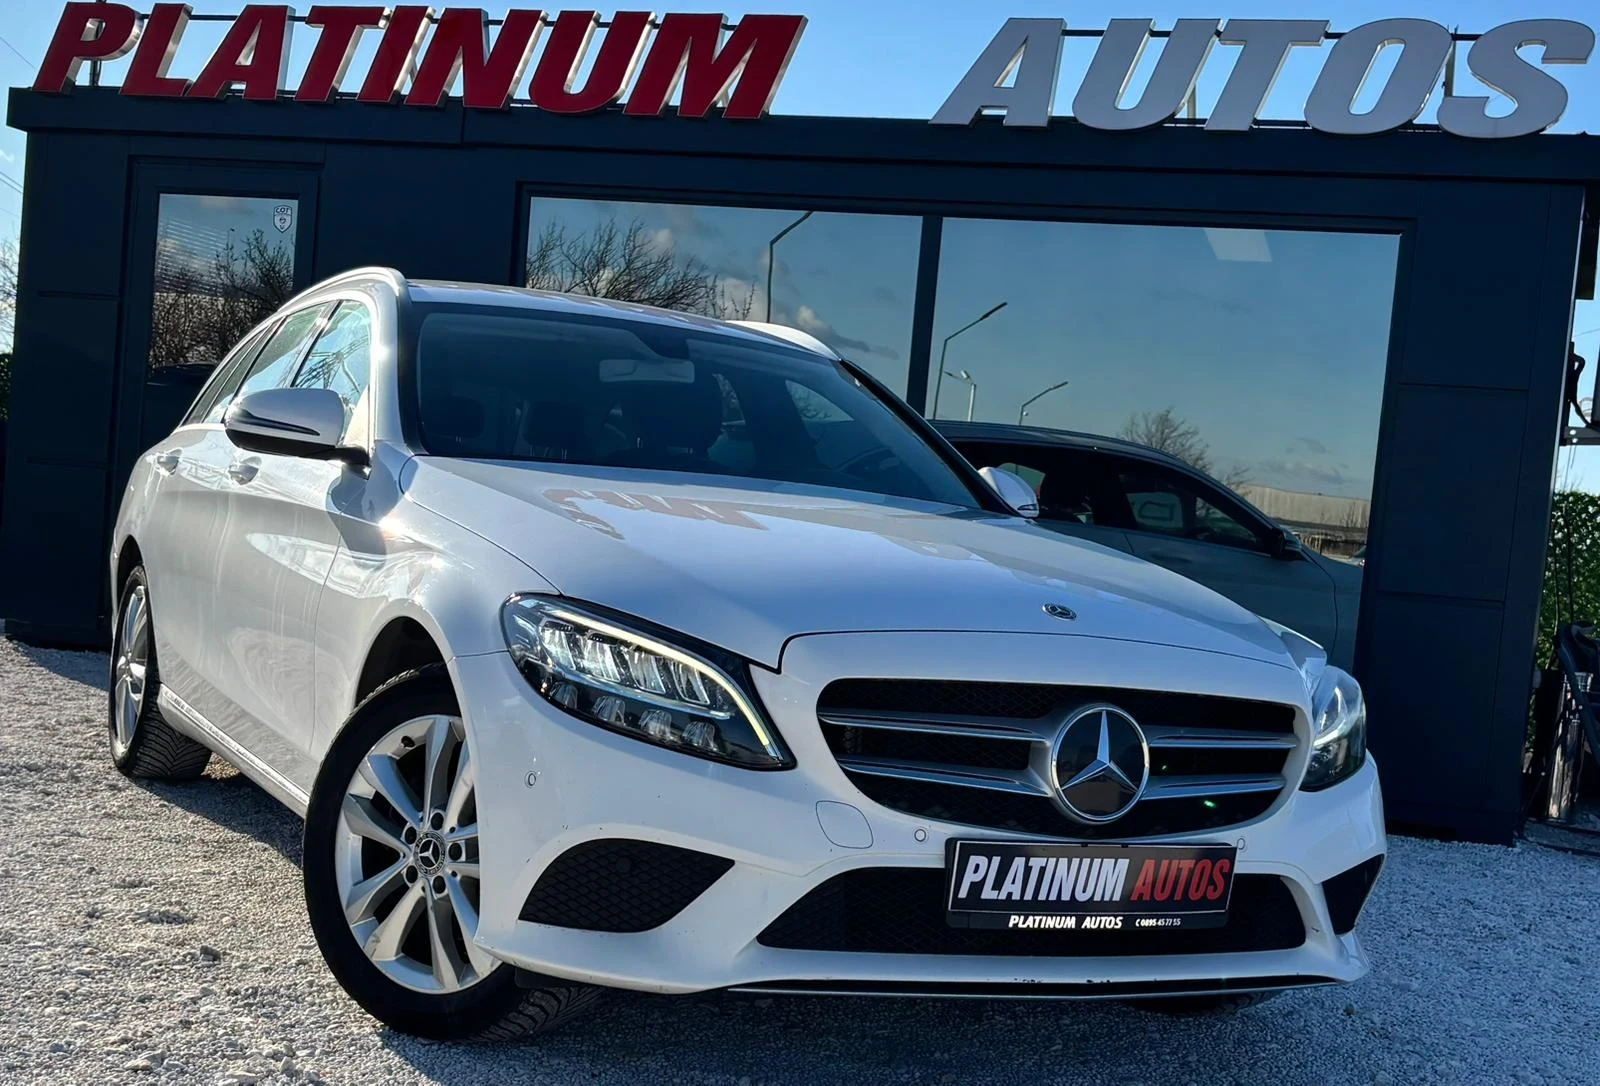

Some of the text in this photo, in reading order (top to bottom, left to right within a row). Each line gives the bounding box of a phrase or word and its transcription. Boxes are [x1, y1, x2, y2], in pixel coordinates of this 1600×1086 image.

[32, 1, 1596, 138] PLATINUM AUTOS
[957, 855, 1229, 902] PLATINUM AUTOS
[1008, 915, 1076, 929] PLATINUM
[1081, 916, 1124, 929] AUTOS
